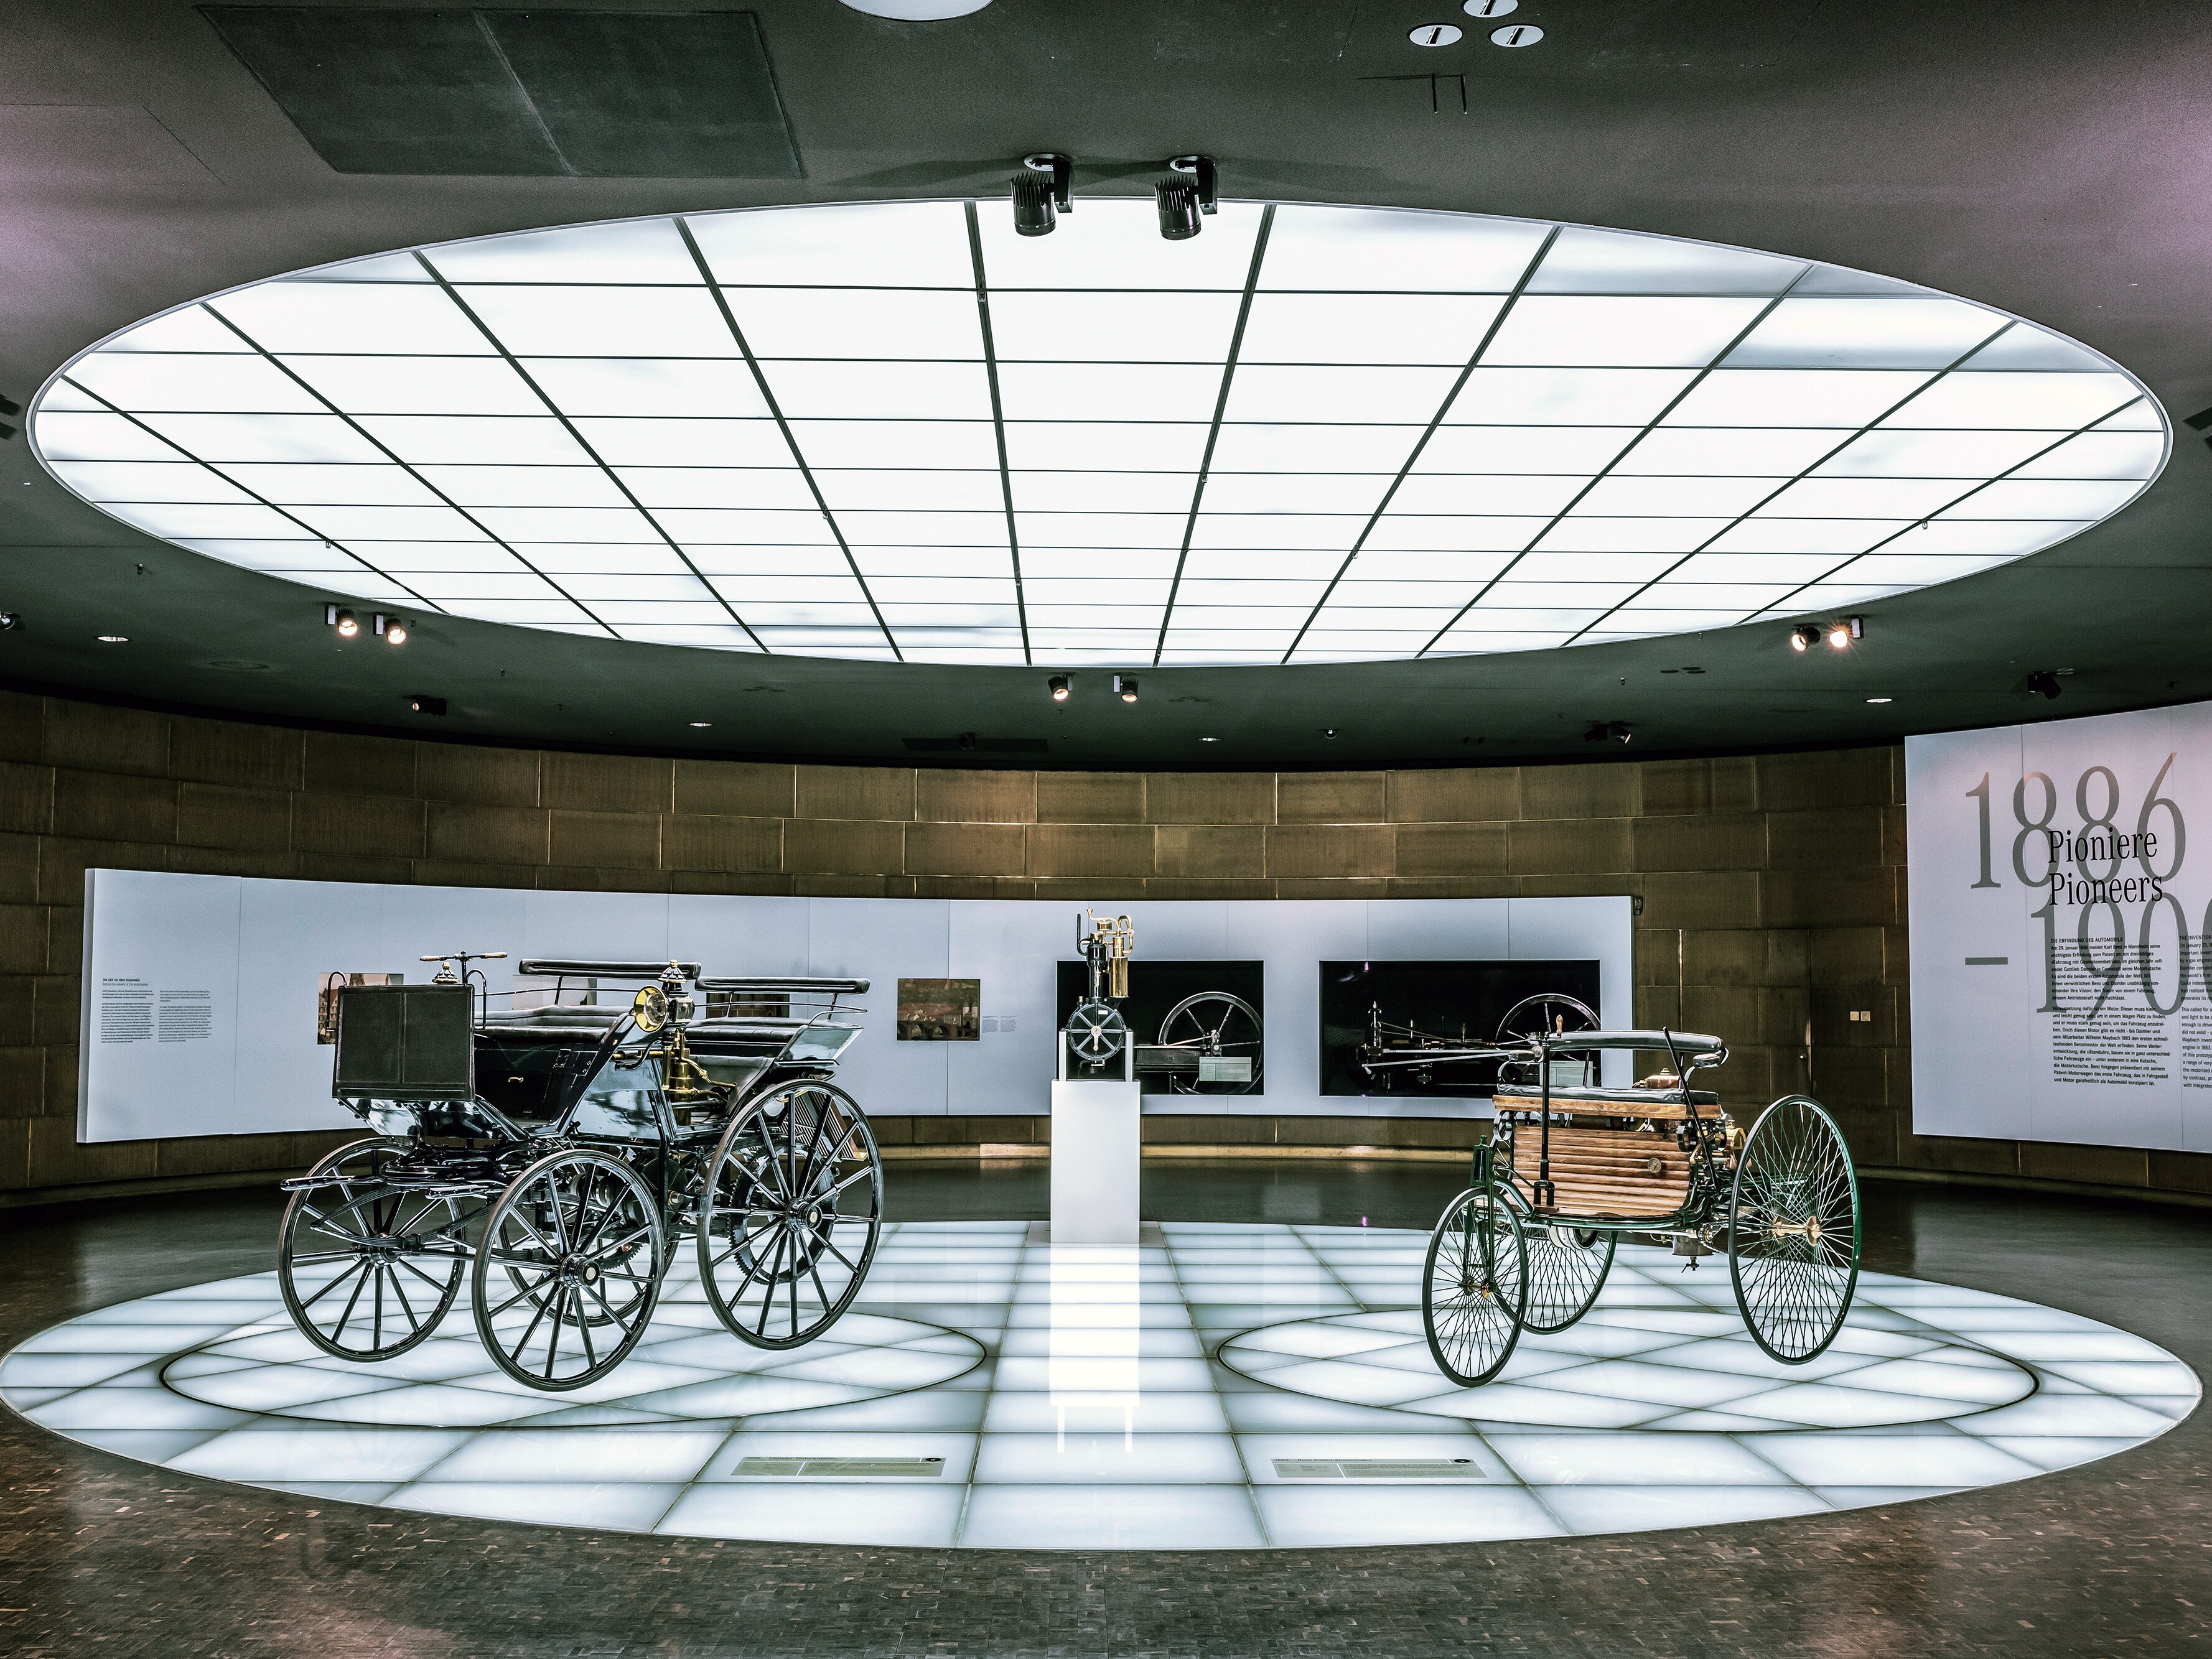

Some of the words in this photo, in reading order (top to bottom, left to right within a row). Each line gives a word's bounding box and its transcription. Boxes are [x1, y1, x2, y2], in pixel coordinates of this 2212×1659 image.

[1966, 753, 2186, 889] 1886
[2048, 827, 2157, 863] Pioniere
[2048, 873, 2163, 906] Pioneers
[2030, 892, 2212, 1021] 190
